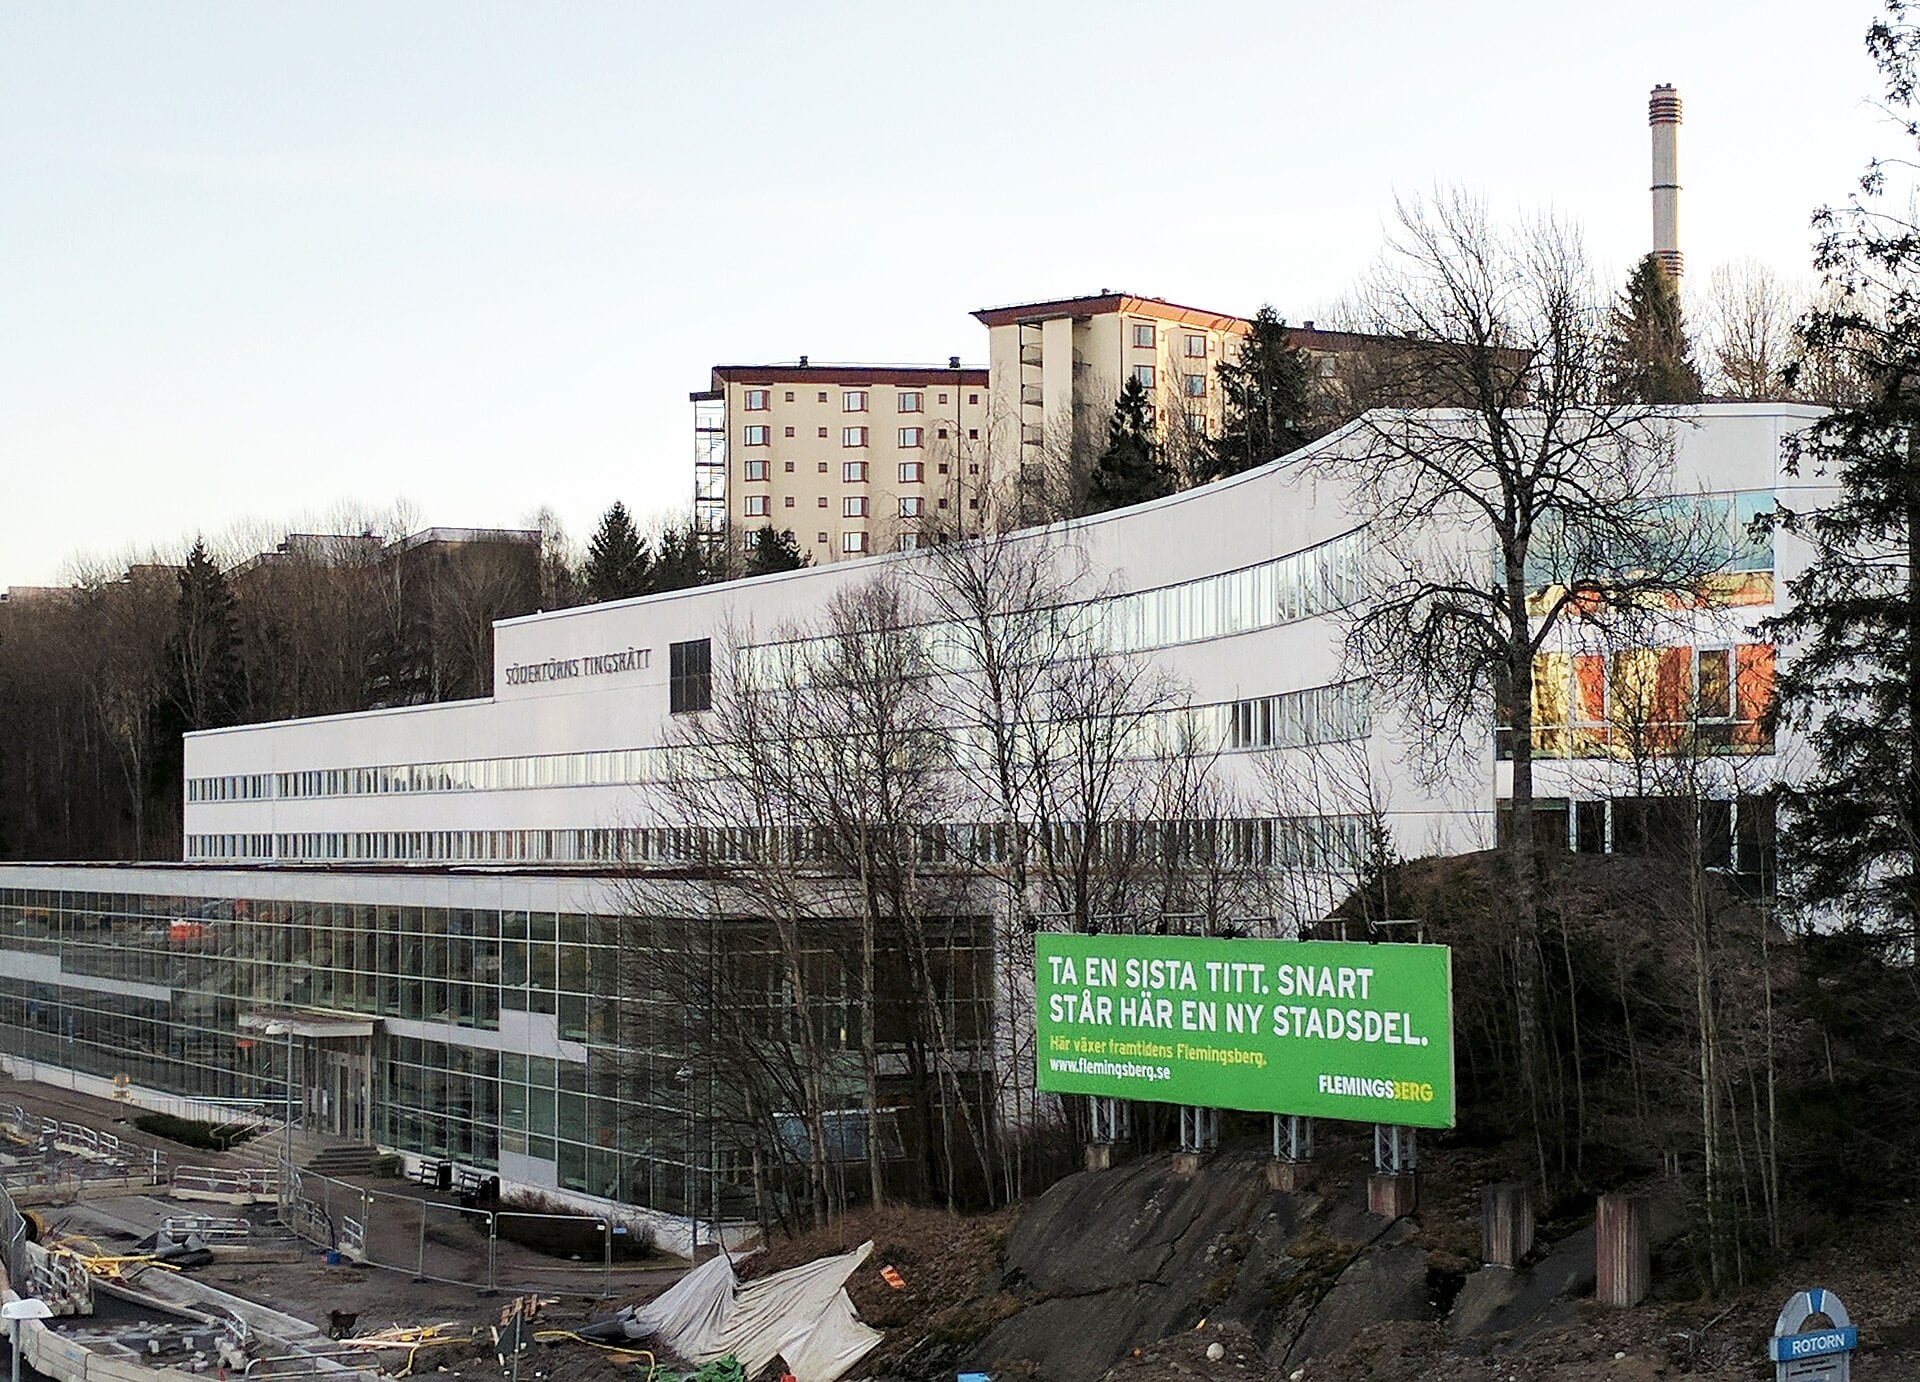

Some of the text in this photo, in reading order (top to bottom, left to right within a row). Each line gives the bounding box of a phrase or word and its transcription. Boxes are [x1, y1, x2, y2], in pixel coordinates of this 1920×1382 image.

[505, 647, 652, 686] SÖDERTÖRNS TINGSRÄTT
[1048, 956, 1374, 1000] TA EN SISTA TITT. SNART
[1050, 988, 1429, 1047] STÅR HÄR EN NY STADSDEL.
[1050, 1035, 1268, 1068] Här växer framtidens Flemingsberg.
[1050, 1057, 1171, 1082] www.flemingsberg.se
[1319, 1074, 1434, 1102] FLEMINGSBERG
[1792, 1333, 1846, 1355] ROTORN
